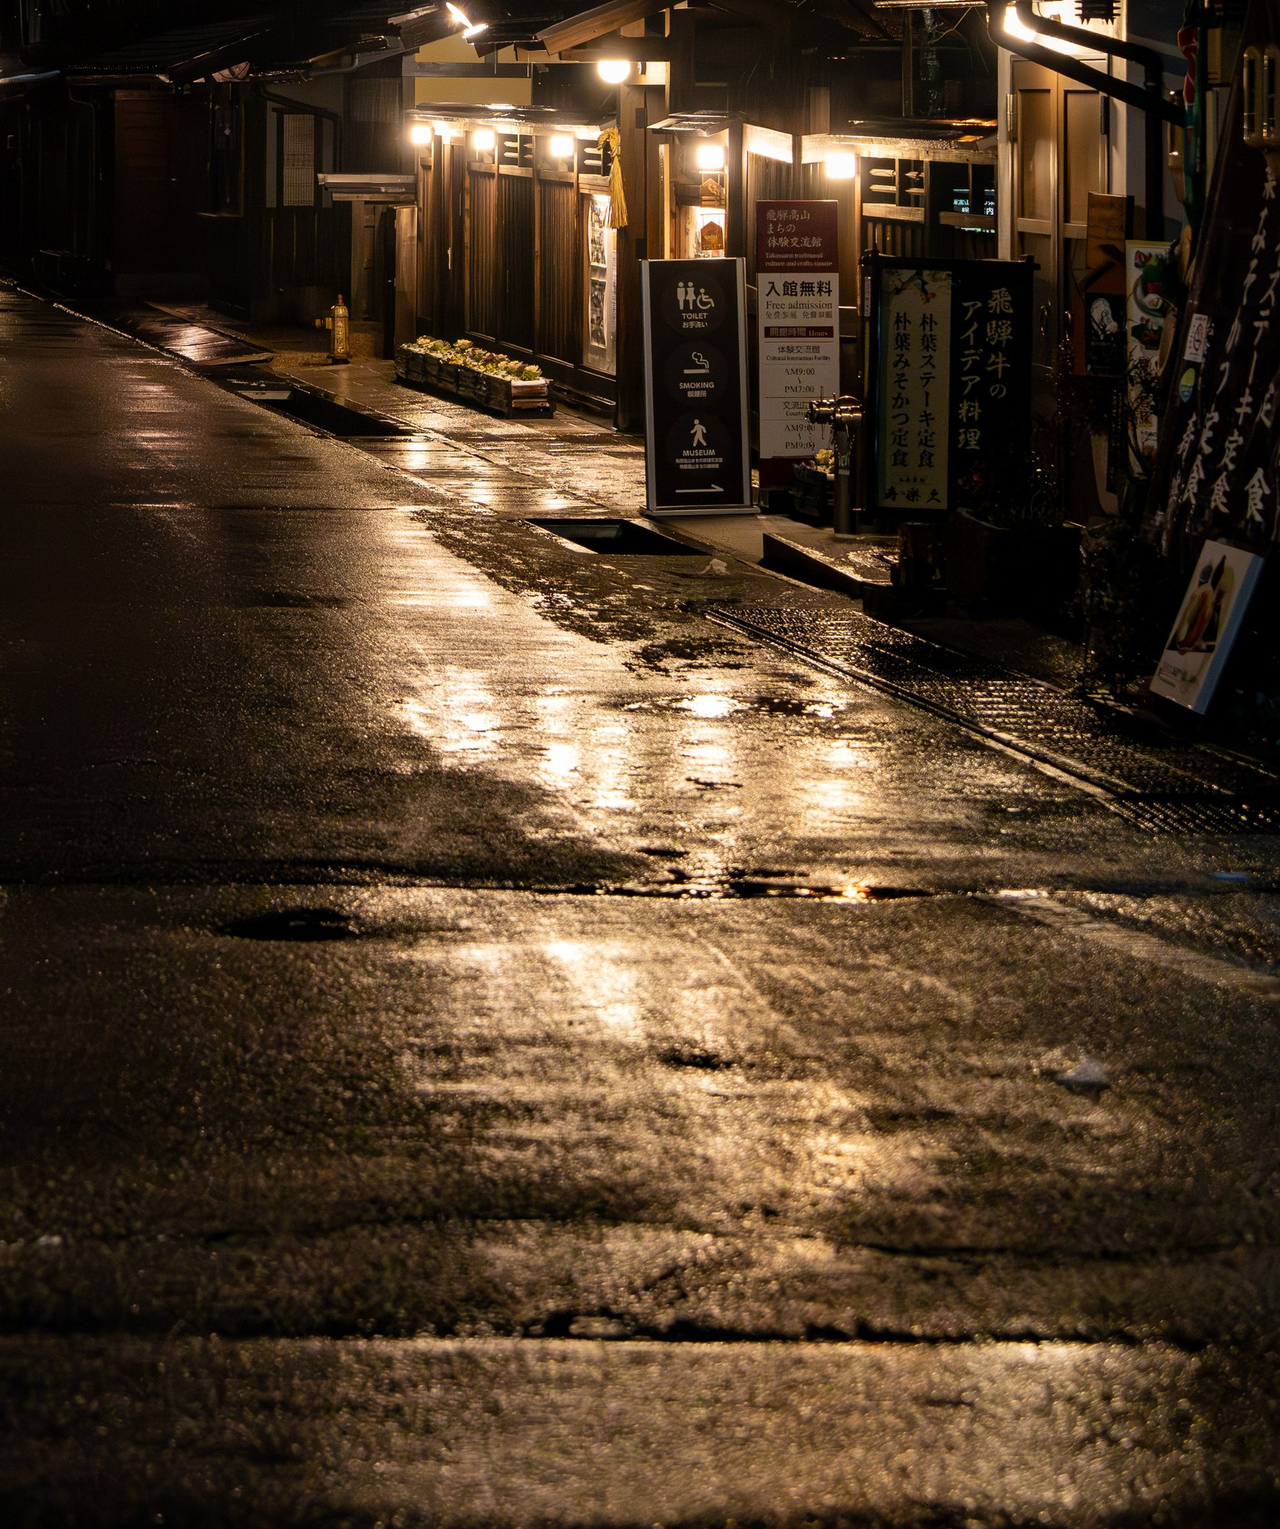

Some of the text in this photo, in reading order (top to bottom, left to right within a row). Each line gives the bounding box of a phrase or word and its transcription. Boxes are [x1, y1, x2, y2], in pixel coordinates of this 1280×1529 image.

[766, 223, 796, 234] まちの
[768, 236, 822, 248] 体験交流館
[765, 280, 833, 297] 入館無料
[766, 301, 833, 310] Free admission
[681, 312, 709, 320] TOILET
[808, 329, 829, 337] Hours
[784, 368, 815, 376] AM9:00
[958, 301, 983, 450] アイデア料理
[679, 381, 715, 390] SMOKING
[784, 385, 815, 393] PM7:00
[891, 311, 912, 469] 朴葉みそかつ定食
[917, 313, 938, 469] 朴葉ステーキ定食
[783, 401, 809, 410] 交流広
[682, 449, 716, 457] MUSEUM
